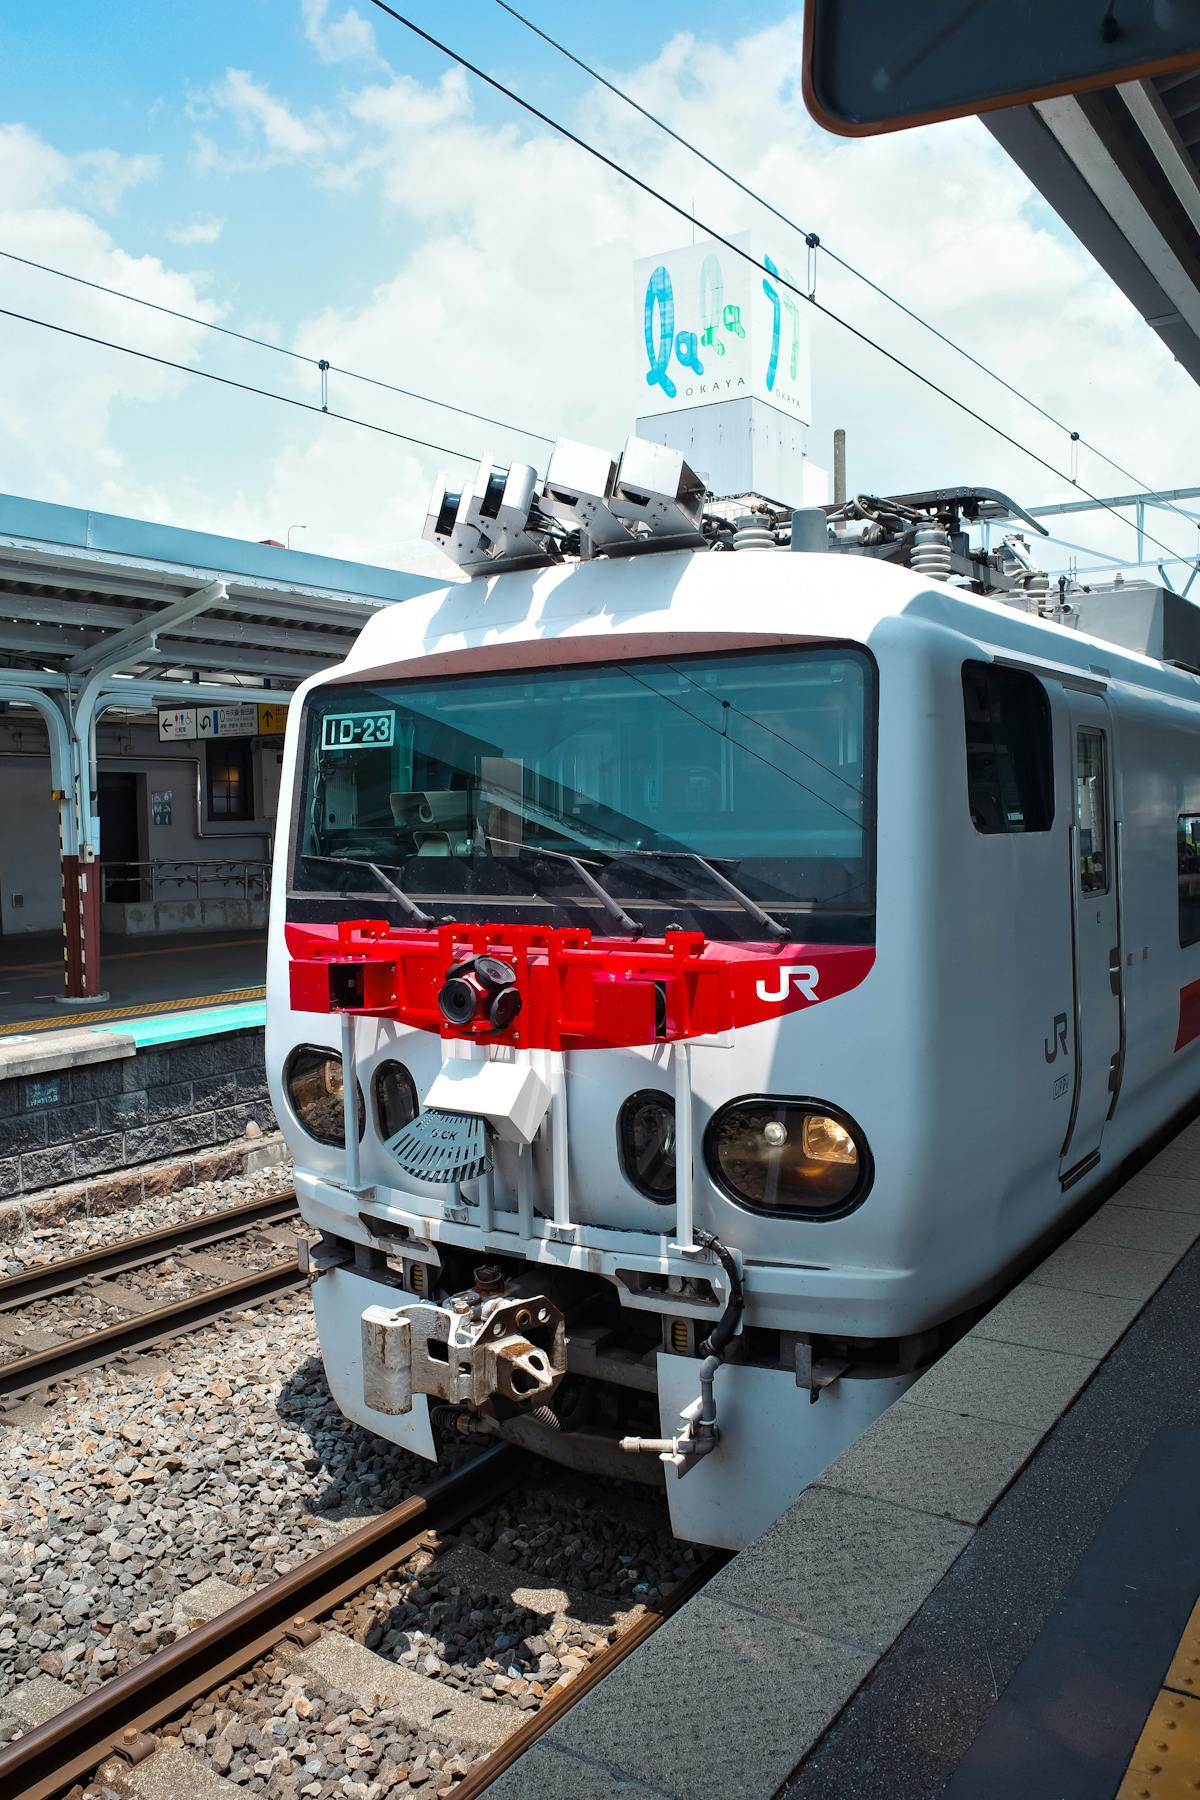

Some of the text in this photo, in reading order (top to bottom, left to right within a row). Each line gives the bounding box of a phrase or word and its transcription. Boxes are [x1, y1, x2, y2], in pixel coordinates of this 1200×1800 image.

[685, 377, 745, 397] OKAYA
[775, 389, 801, 409] OKAYA
[330, 717, 389, 744] ID-23
[756, 965, 819, 1002] JR
[1045, 1012, 1068, 1064] JR
